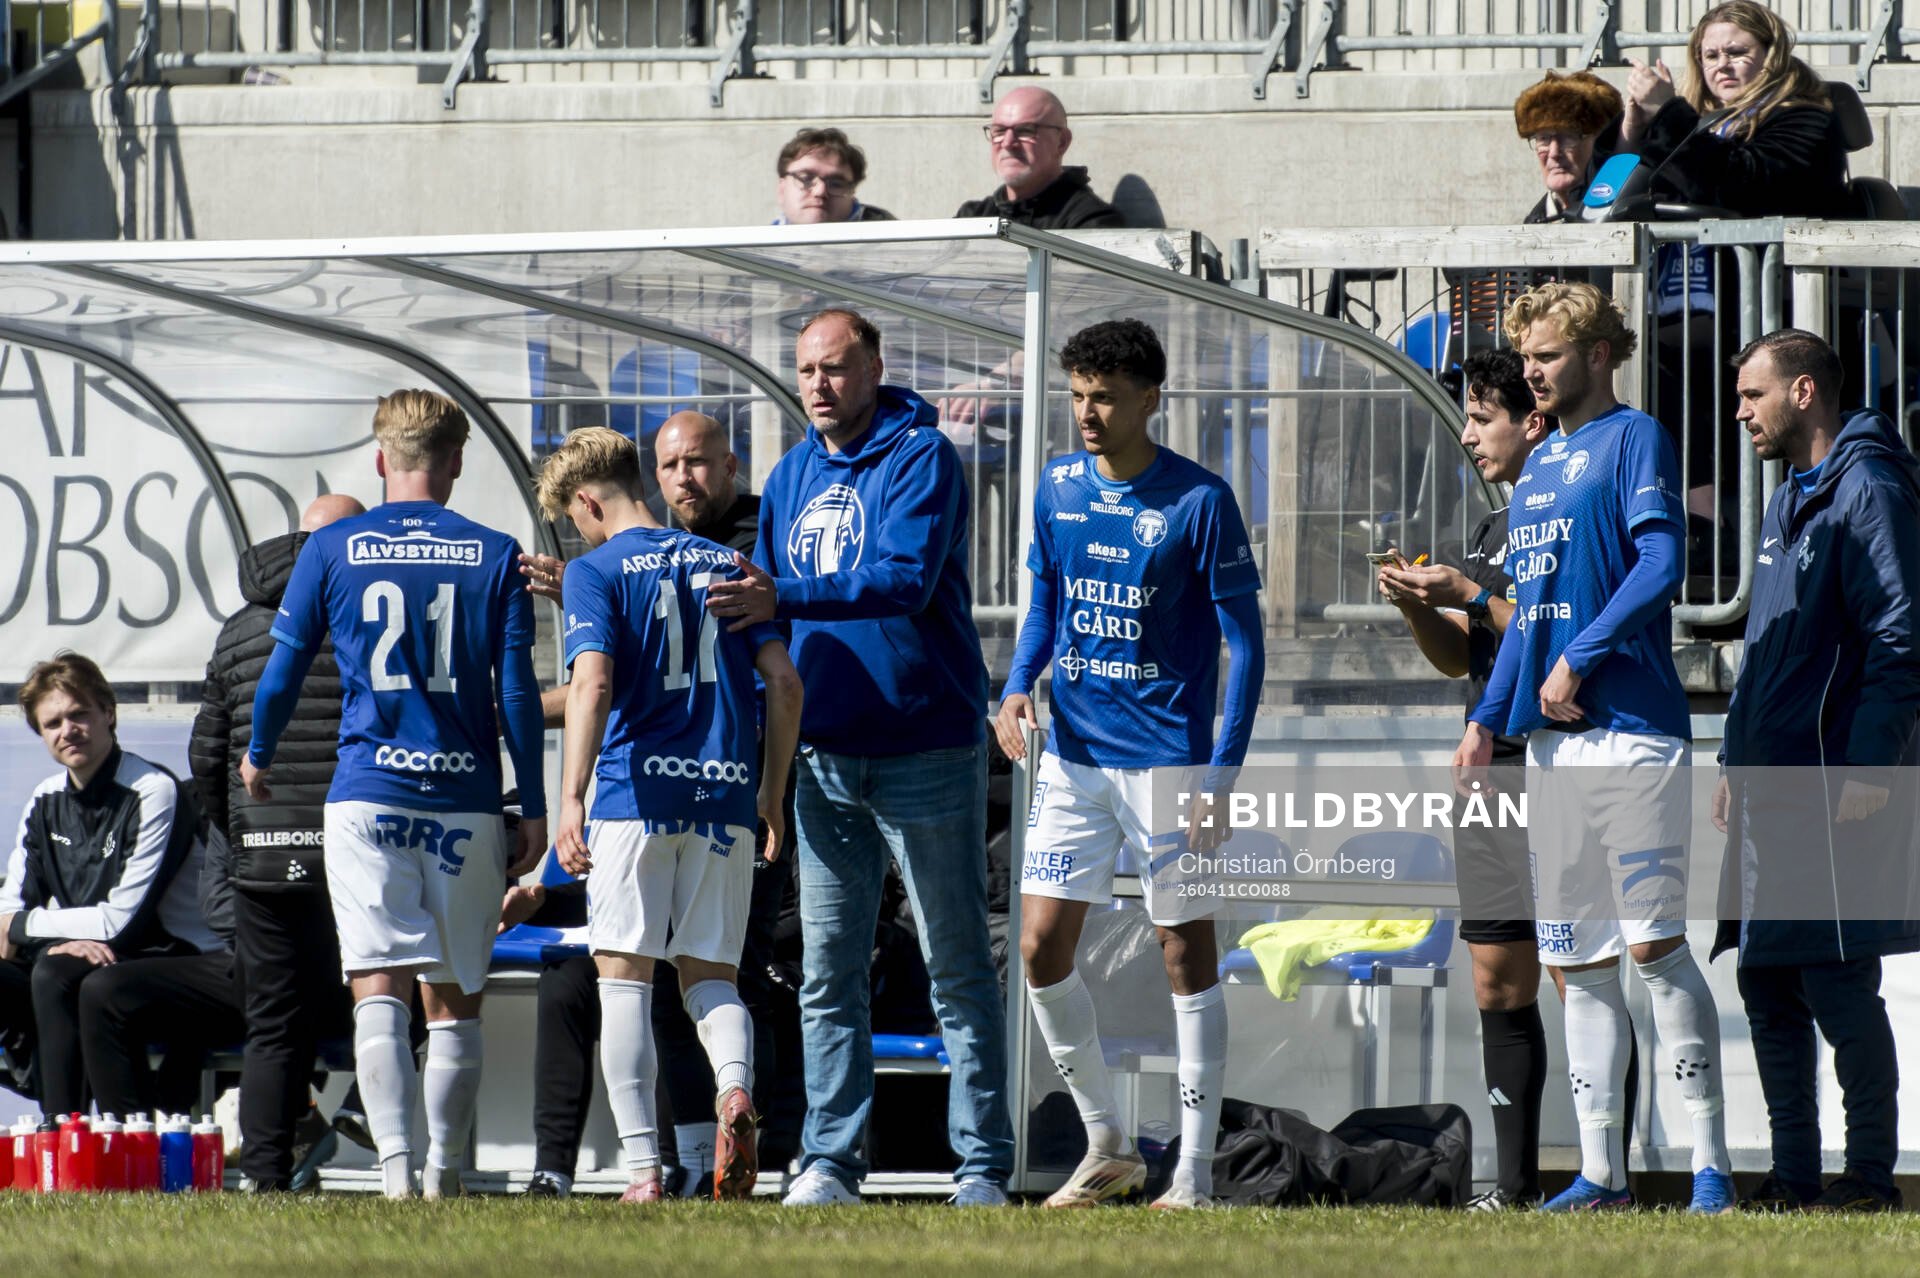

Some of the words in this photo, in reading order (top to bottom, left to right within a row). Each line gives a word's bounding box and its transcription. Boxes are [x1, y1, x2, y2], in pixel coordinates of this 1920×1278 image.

[1089, 501, 1135, 517] TRELLEBORG
[1508, 518, 1574, 554] MELLBY
[355, 541, 476, 560] ÄLVSBYHUS
[1087, 542, 1117, 557] akea
[622, 552, 669, 575] AROS
[1065, 576, 1158, 609] MELLBY
[655, 572, 726, 691] 17
[1073, 606, 1143, 641] GÅRD
[362, 580, 457, 693] 21
[242, 831, 325, 847] TRELLEBORG
[376, 814, 473, 866] RRC
[709, 843, 731, 858] Rail
[439, 862, 462, 877] Rail
[1024, 866, 1071, 884] SPORT
[1537, 921, 1574, 938] NTER
